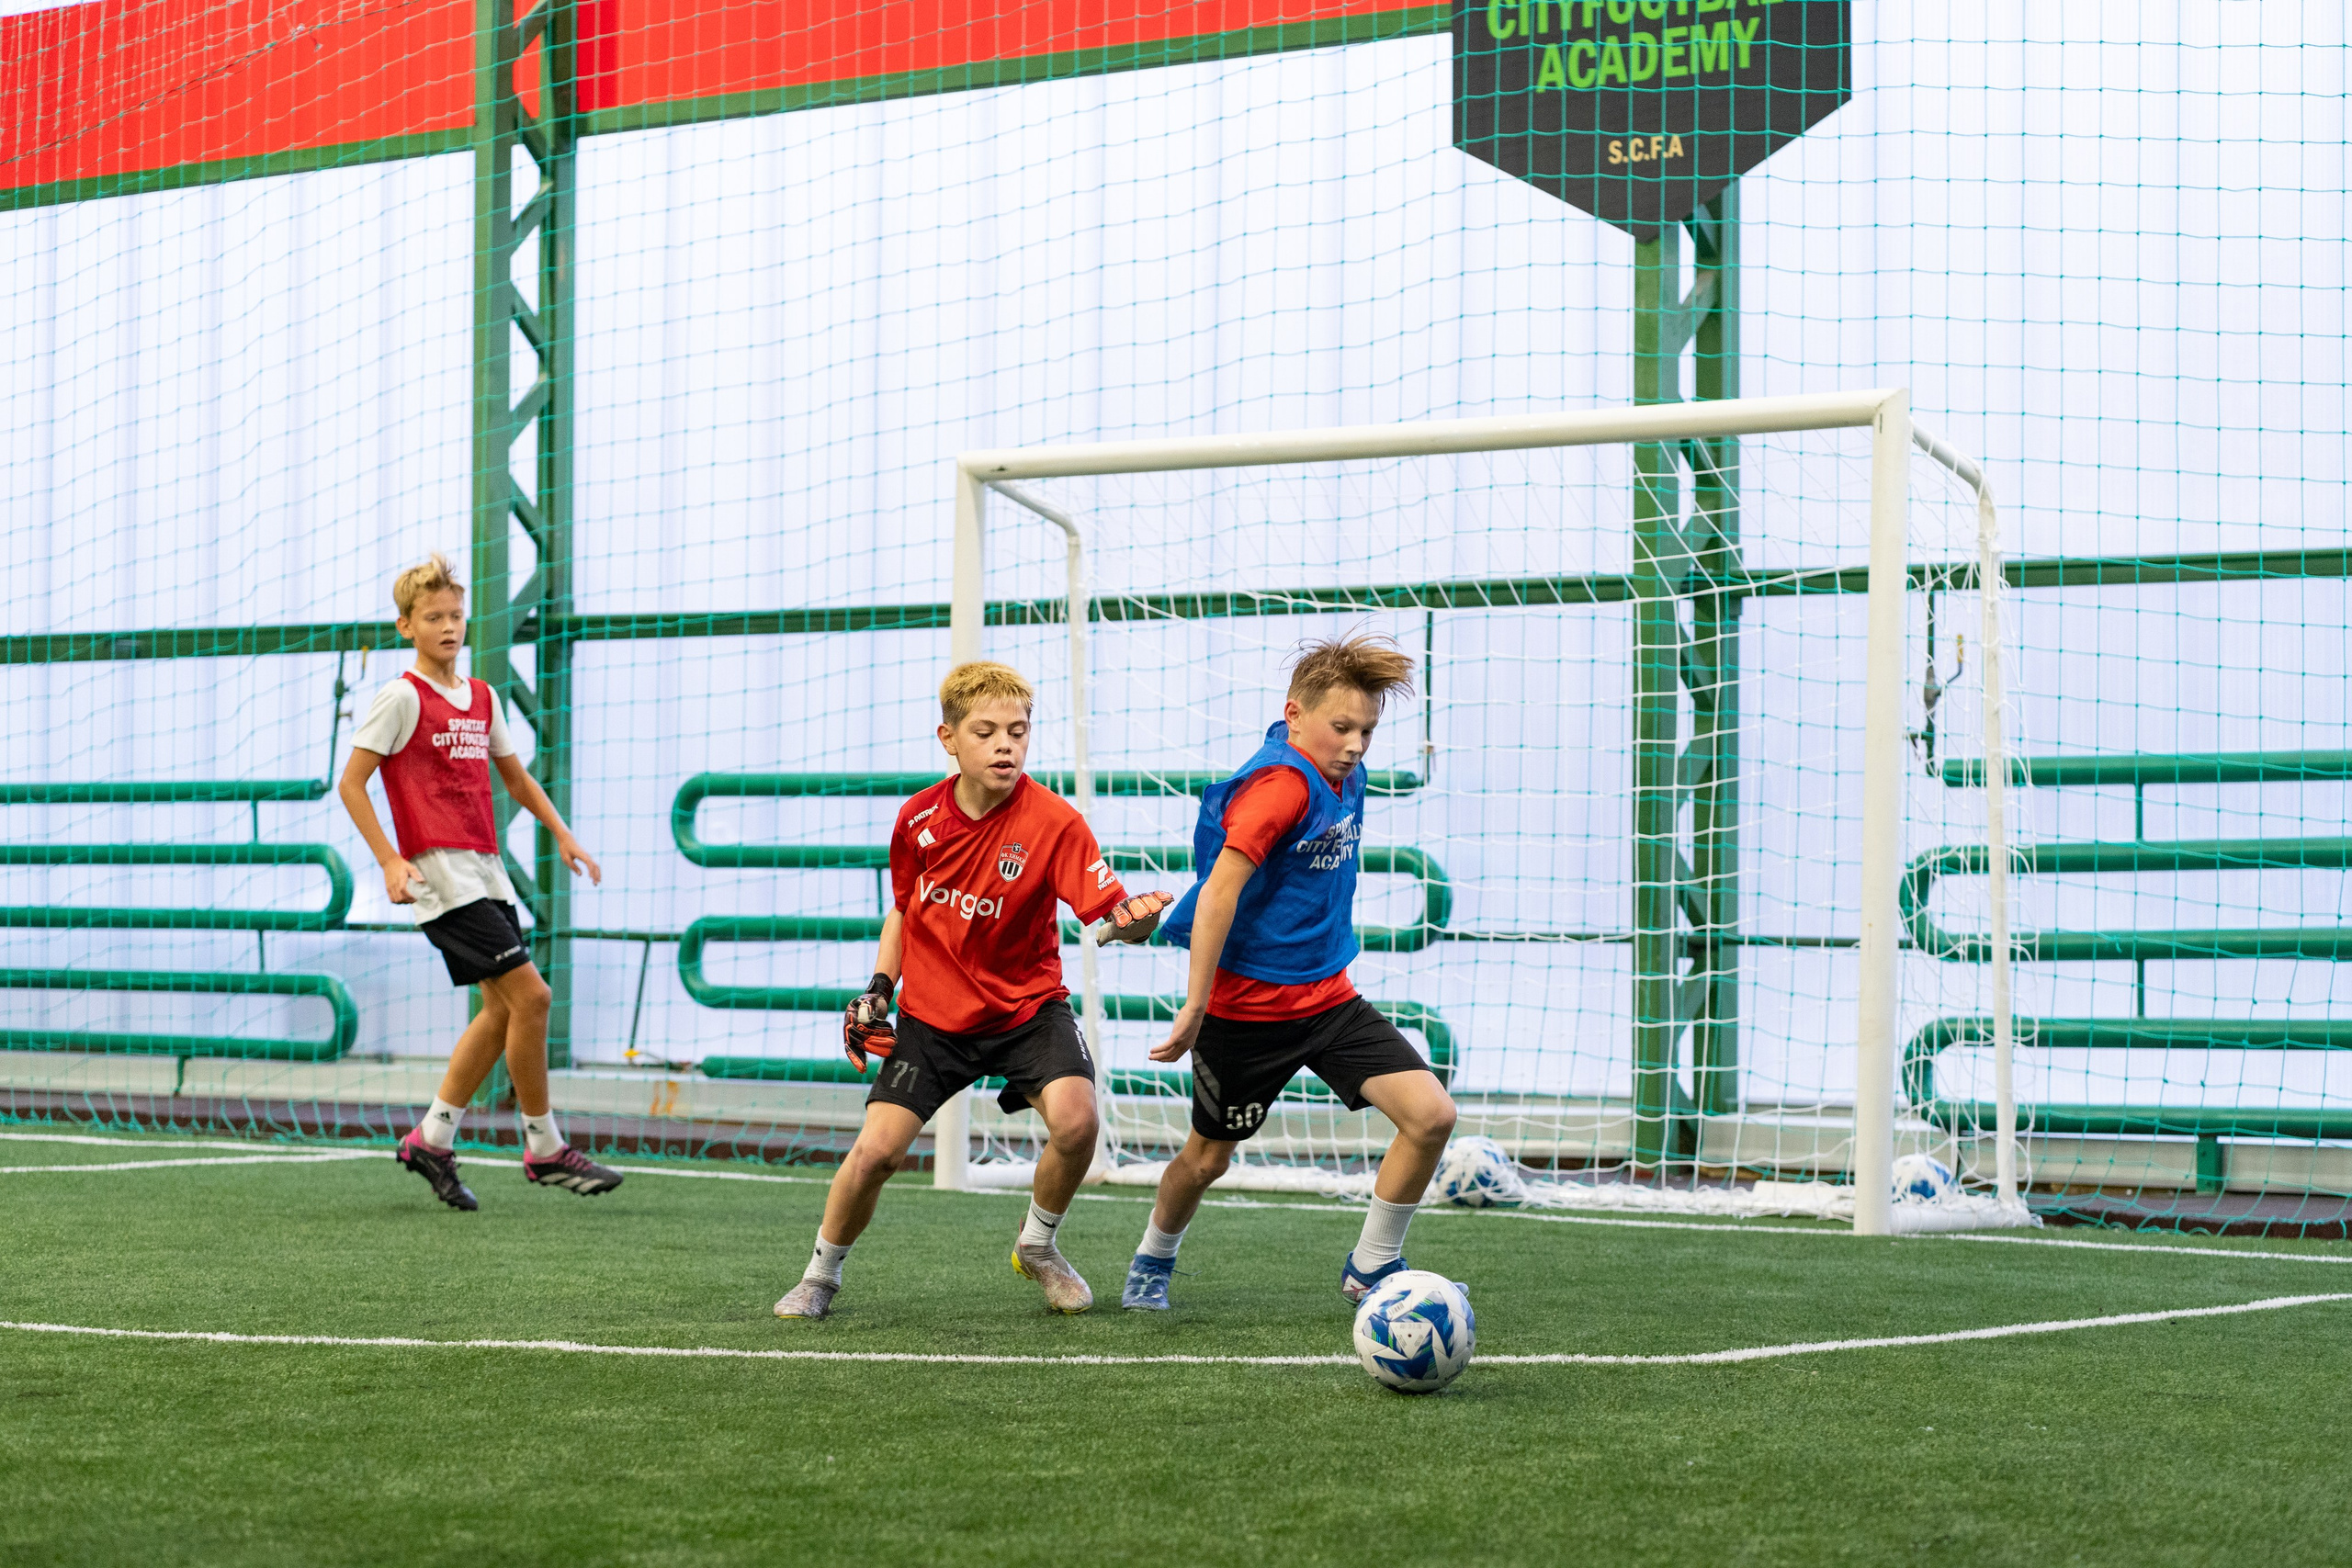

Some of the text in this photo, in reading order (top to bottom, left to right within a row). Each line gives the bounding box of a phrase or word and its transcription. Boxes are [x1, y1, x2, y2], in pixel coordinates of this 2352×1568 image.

[1535, 17, 1761, 93] ACADEMY
[1608, 134, 1684, 164] S.C.F.A
[432, 732, 458, 747] CITY
[1296, 839, 1332, 853] CITY
[919, 874, 1004, 920] Vorgol
[890, 1060, 920, 1093] 71
[1226, 1102, 1264, 1130] 50
